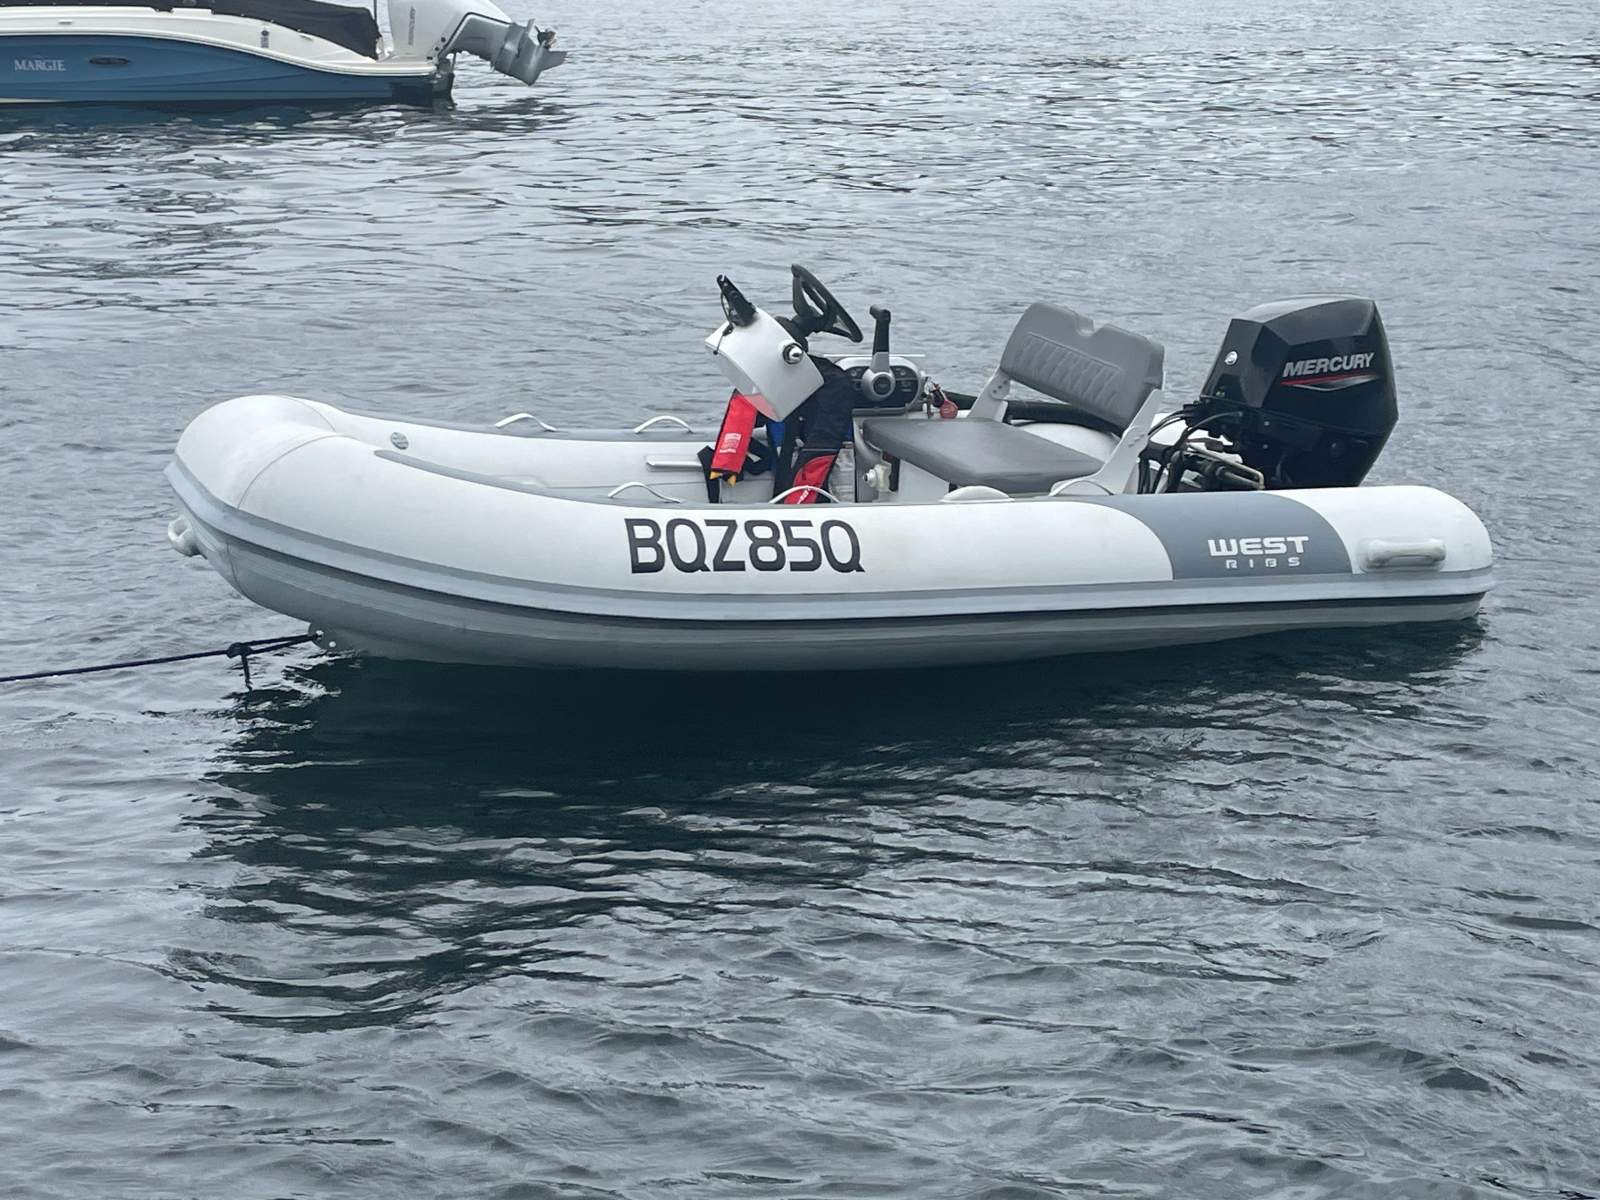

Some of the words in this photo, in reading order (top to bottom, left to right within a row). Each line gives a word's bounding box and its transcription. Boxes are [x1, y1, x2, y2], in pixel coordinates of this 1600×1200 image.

[14, 59, 66, 71] MARGIE
[1283, 352, 1374, 378] MERCURY
[624, 518, 865, 573] BQZ85Q
[1207, 536, 1309, 556] WEST
[1225, 557, 1301, 569] RIBS
